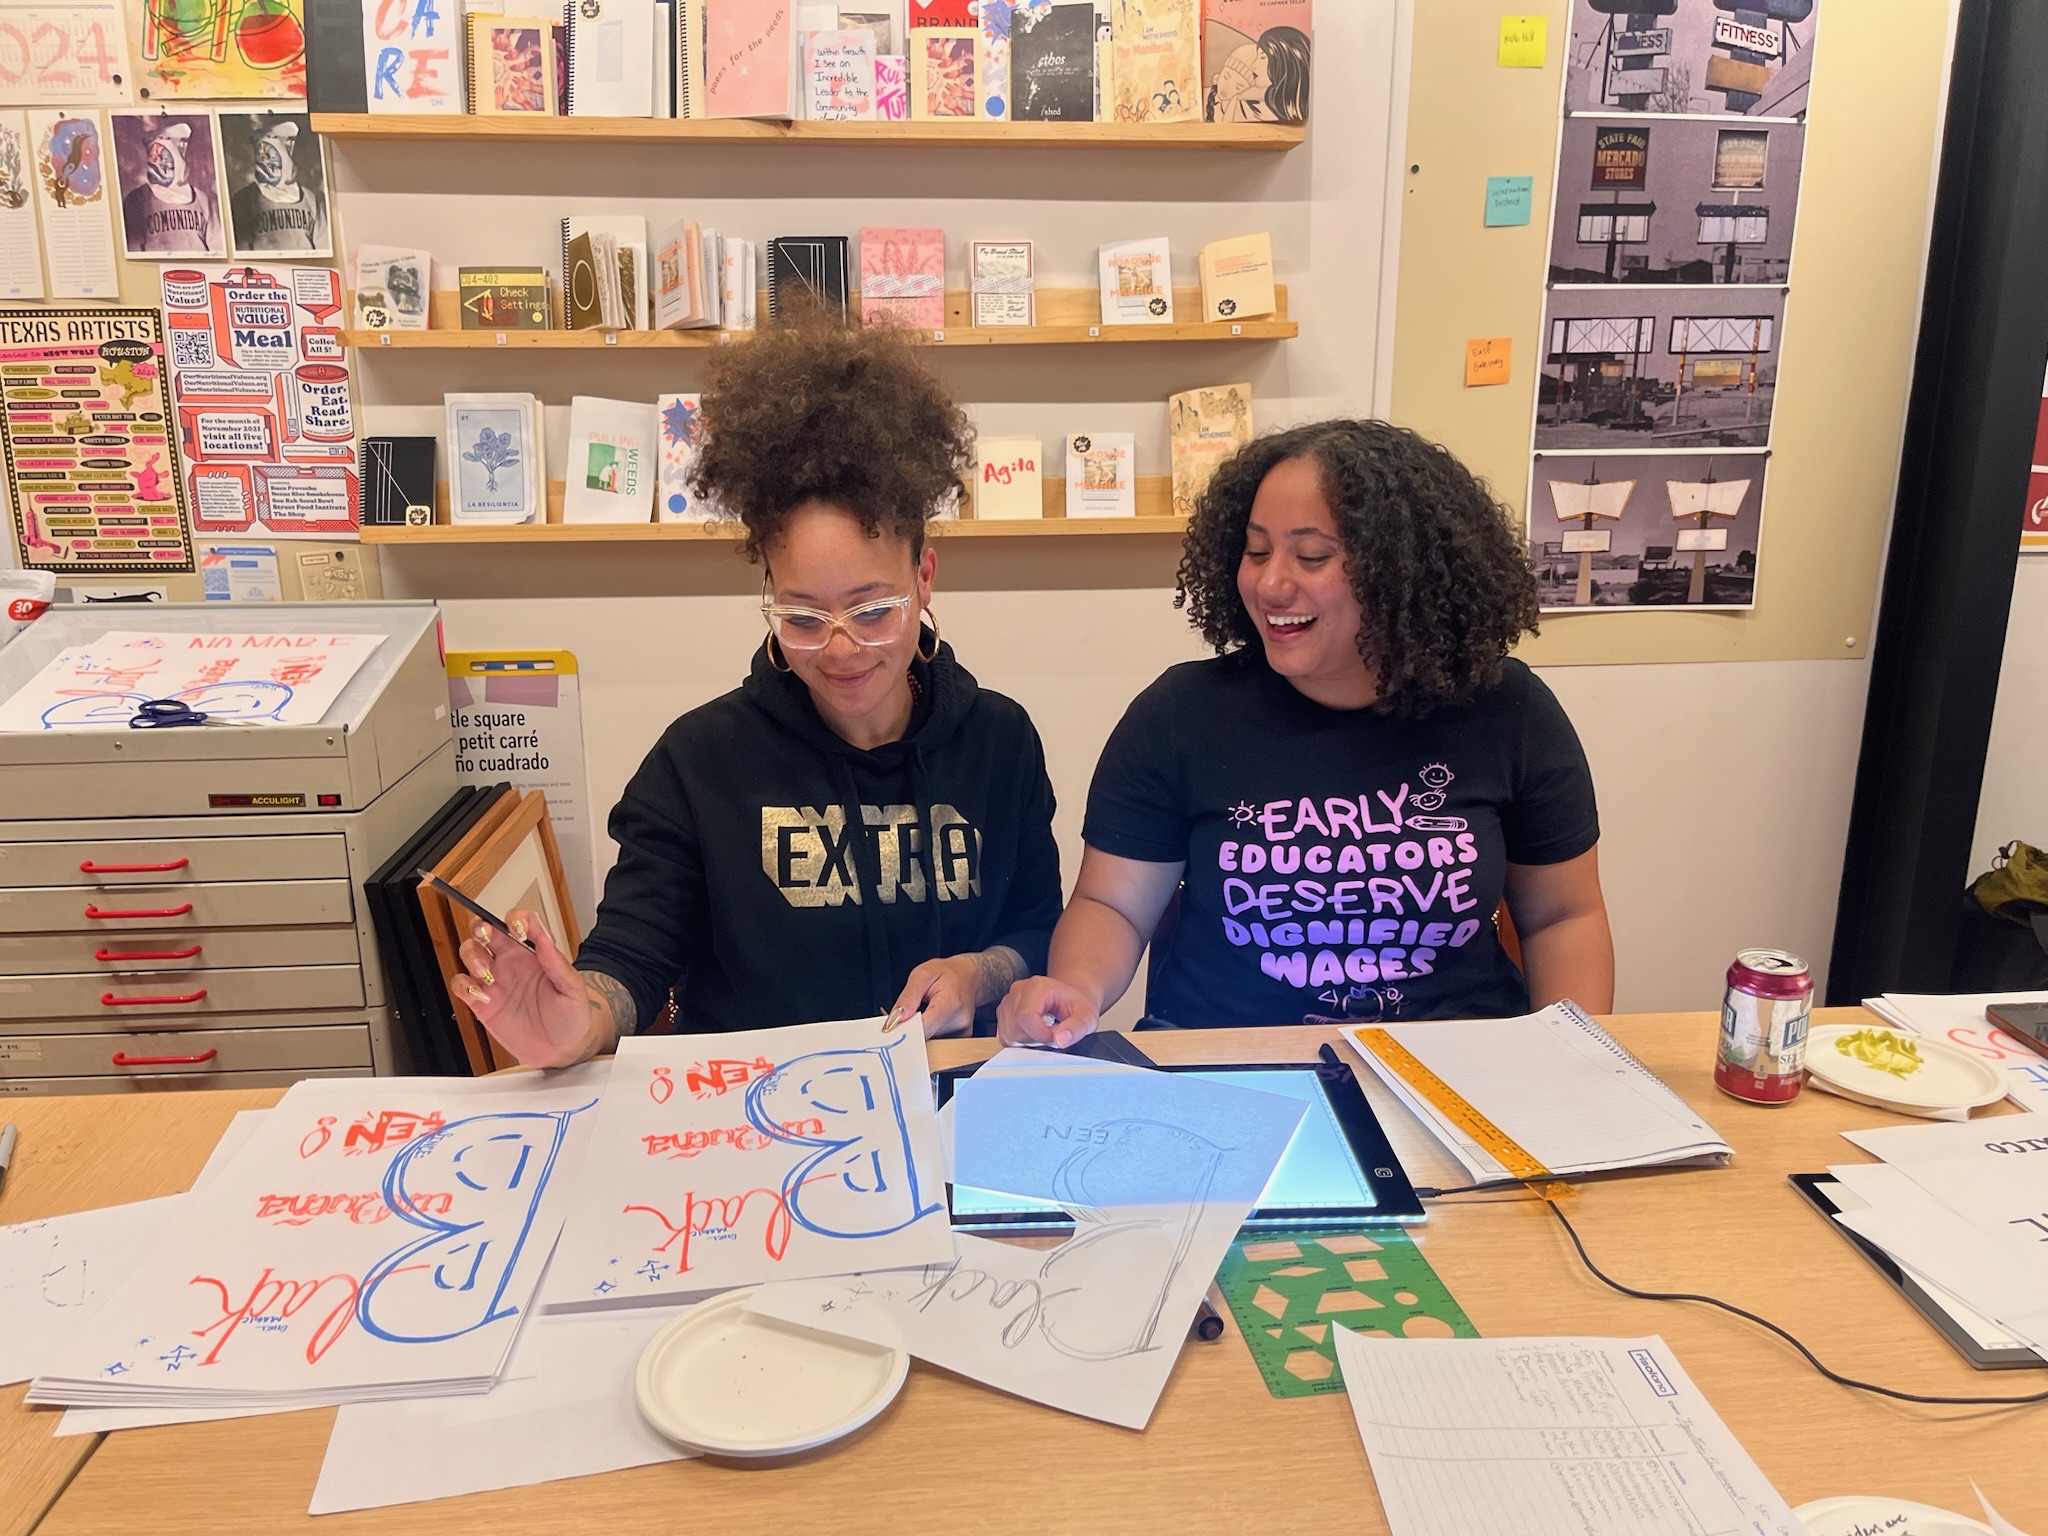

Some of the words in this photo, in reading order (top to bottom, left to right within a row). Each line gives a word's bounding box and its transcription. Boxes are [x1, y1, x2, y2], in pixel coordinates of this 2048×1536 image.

[1720, 23, 1774, 48] FITNESS
[709, 66, 727, 95] poems
[729, 49, 744, 66] for
[748, 37, 763, 51] the
[1038, 51, 1066, 68] ethos
[814, 72, 858, 83] Incredible
[815, 88, 841, 97] Leader
[845, 88, 853, 97] to
[855, 88, 869, 97] the
[815, 103, 857, 116] Community
[1598, 133, 1624, 149] STATE
[1596, 150, 1645, 167] MERCADO
[167, 294, 205, 304] Values?
[229, 290, 265, 300] Order
[267, 291, 288, 300] the
[500, 287, 529, 298] Check
[235, 306, 285, 314] NUTRITIONAL
[0, 321, 61, 344] TEXAS
[68, 320, 150, 341] ARTISTS
[234, 330, 293, 348] Meal
[308, 337, 336, 345] Collec
[101, 346, 151, 357] HOUSTON
[302, 383, 347, 394] Order.
[321, 396, 348, 406] Eat.
[311, 406, 349, 416] Read.
[305, 415, 350, 427] Share.
[204, 441, 263, 450] locations!
[589, 432, 640, 447] PULLING
[626, 448, 639, 496] WEEDS
[984, 457, 1035, 485] Agita
[14, 602, 33, 614] 30
[474, 713, 526, 731] square
[459, 732, 495, 754] petit
[499, 729, 539, 748] carré
[479, 752, 549, 772] cuadrado
[252, 796, 300, 805] ACCULIGHT
[1258, 783, 1409, 841] EARLY
[761, 804, 983, 908] EXTRA
[1218, 832, 1478, 874] EDUCATORS
[1222, 868, 1478, 920] DESERVE
[1221, 916, 1480, 947] DIGNIFIED
[1260, 947, 1437, 988] WAGES
[1635, 1352, 1667, 1394] risolana
